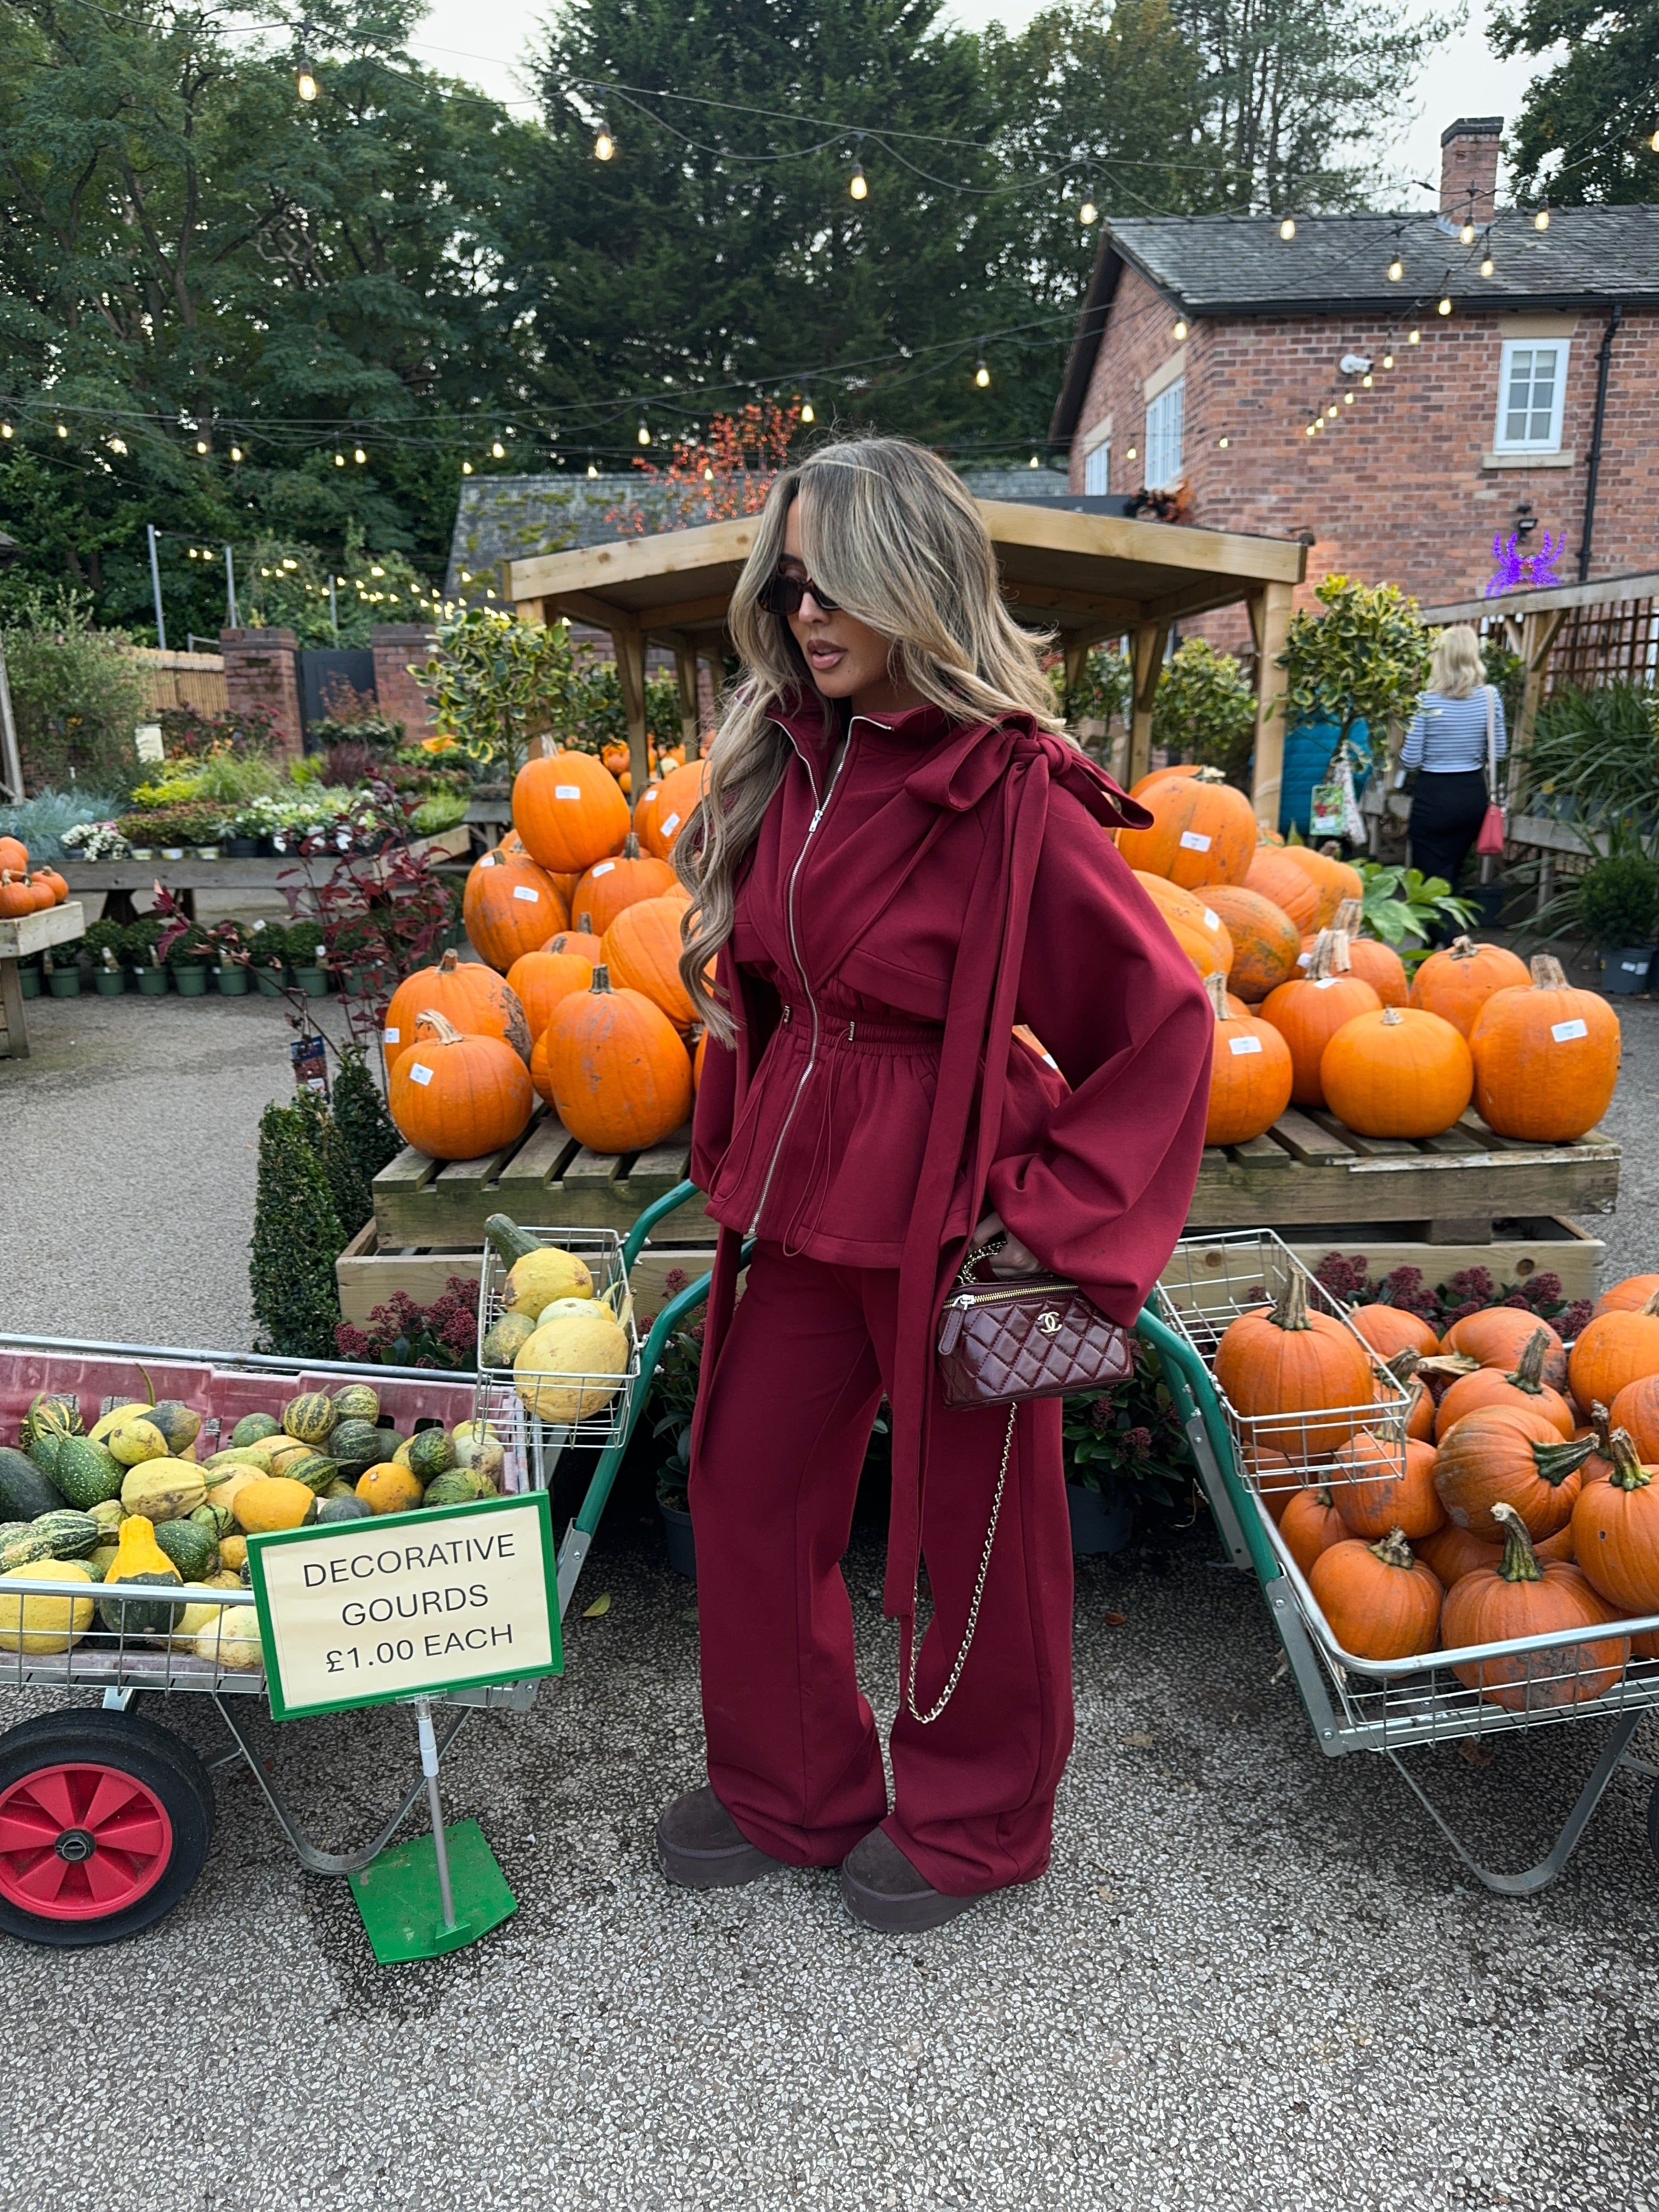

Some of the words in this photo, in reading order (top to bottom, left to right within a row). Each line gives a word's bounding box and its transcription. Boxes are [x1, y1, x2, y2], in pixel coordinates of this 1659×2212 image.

[303, 1533, 515, 1588] DECORATIVE
[342, 1584, 488, 1626] GOURDS
[326, 1639, 414, 1673] £1.00
[424, 1623, 513, 1656] EACH
